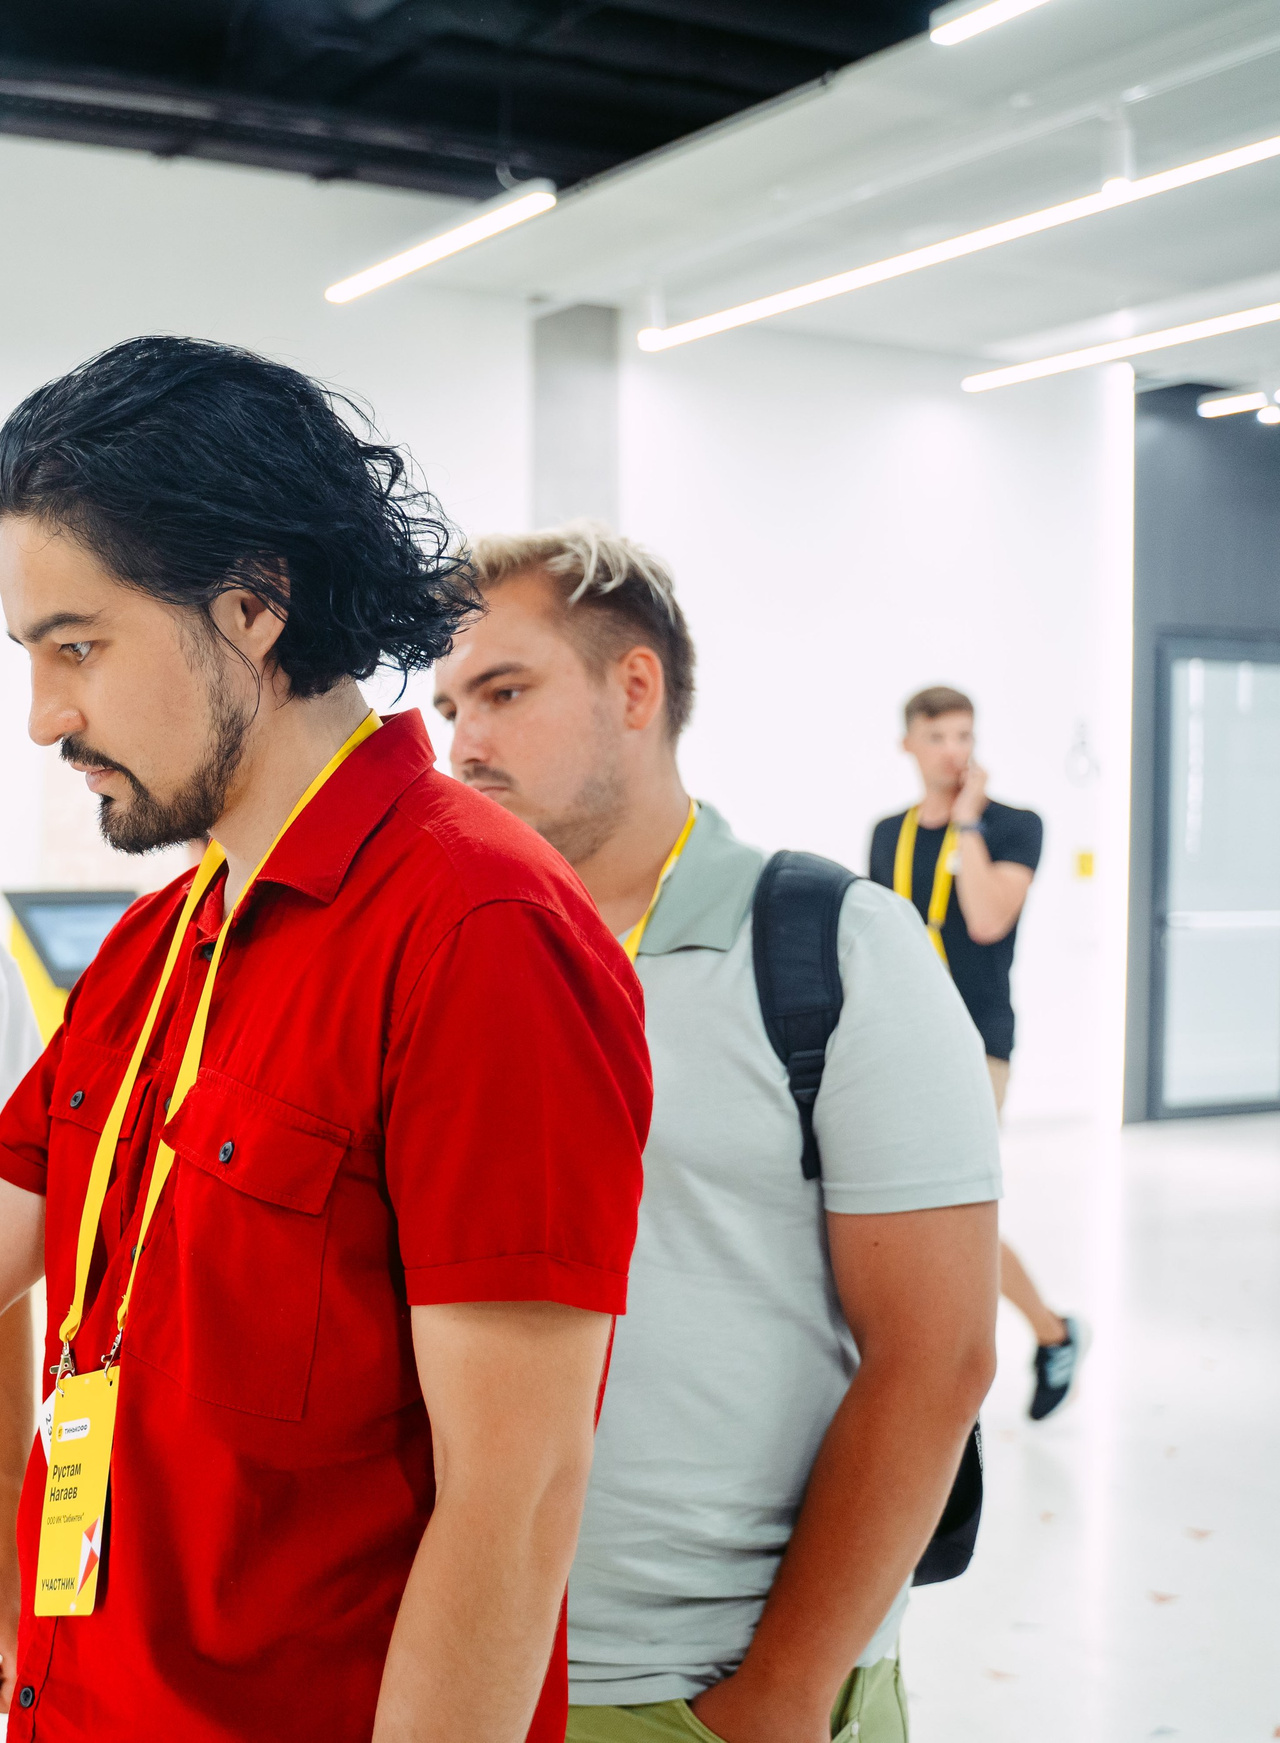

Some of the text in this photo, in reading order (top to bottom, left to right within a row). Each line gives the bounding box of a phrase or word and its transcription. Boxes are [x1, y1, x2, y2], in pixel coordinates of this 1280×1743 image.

[52, 1463, 82, 1482] Рустам
[50, 1486, 78, 1502] Нагаев
[41, 1578, 76, 1592] УЧАСТНИК
